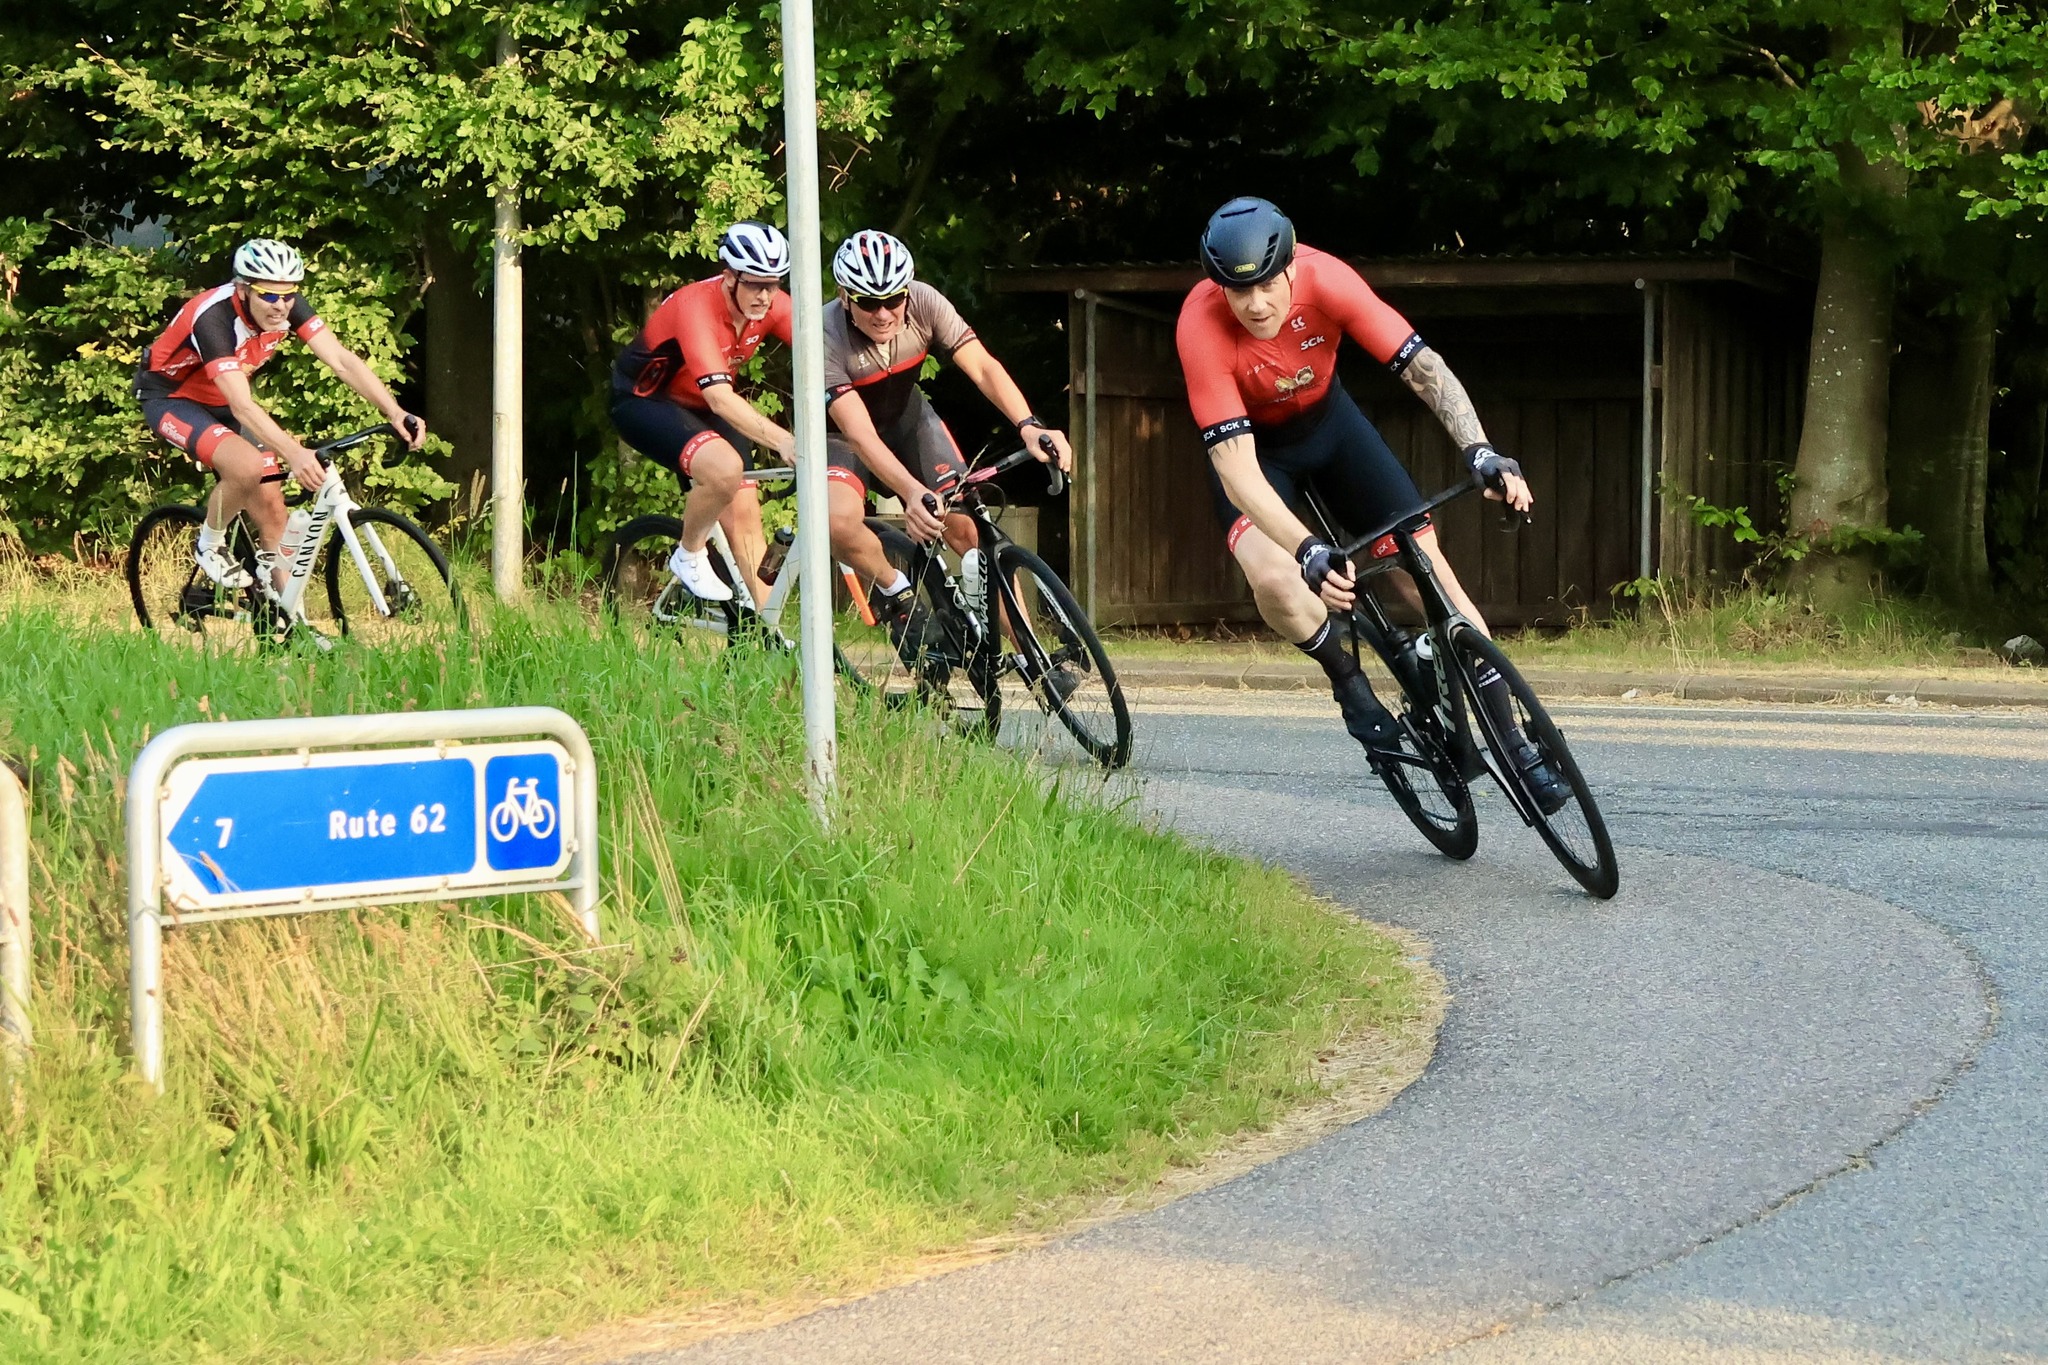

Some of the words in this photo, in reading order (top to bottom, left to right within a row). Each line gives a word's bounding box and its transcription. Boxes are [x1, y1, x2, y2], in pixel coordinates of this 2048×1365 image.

[1300, 335, 1326, 351] SCK
[1399, 341, 1416, 359] SCK
[218, 361, 240, 372] SCK
[1219, 421, 1241, 433] SCK
[827, 470, 850, 479] CK
[291, 511, 329, 578] CANYON
[978, 549, 990, 645] PINARELLO
[214, 817, 234, 850] 7
[328, 808, 397, 841] Rute
[409, 802, 447, 835] 62
